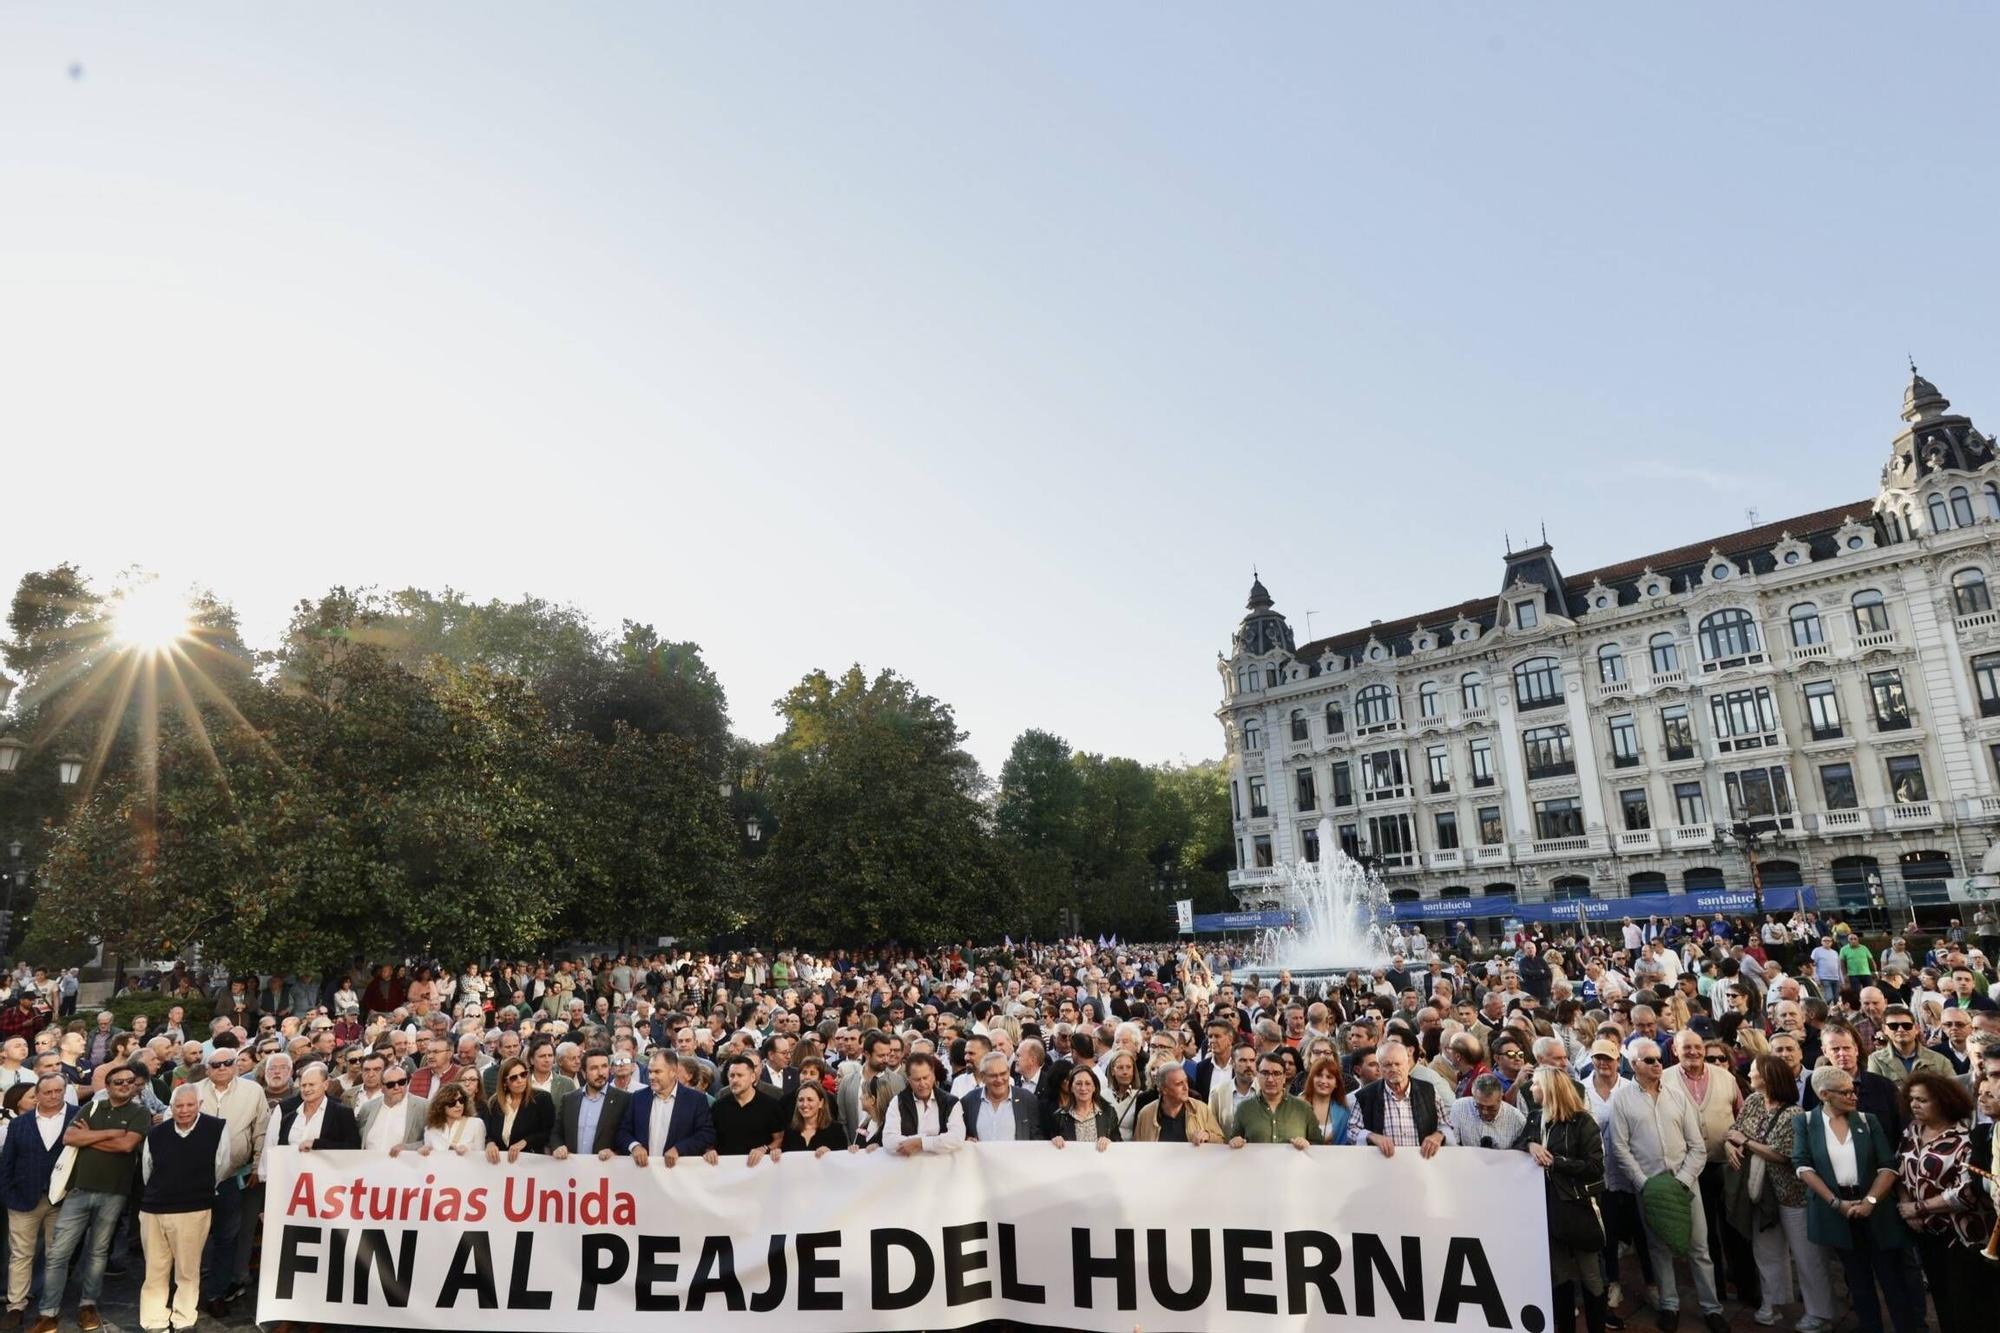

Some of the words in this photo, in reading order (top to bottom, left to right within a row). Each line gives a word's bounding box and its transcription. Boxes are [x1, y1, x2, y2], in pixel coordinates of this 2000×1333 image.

[286, 1172, 489, 1223] Asturias
[502, 1176, 638, 1227] Unida
[275, 1224, 418, 1309] FIN
[435, 1230, 554, 1310] AL
[577, 1231, 844, 1313] PEAJE
[870, 1221, 1047, 1311] DEL
[1071, 1227, 1547, 1333] HUERNA.
